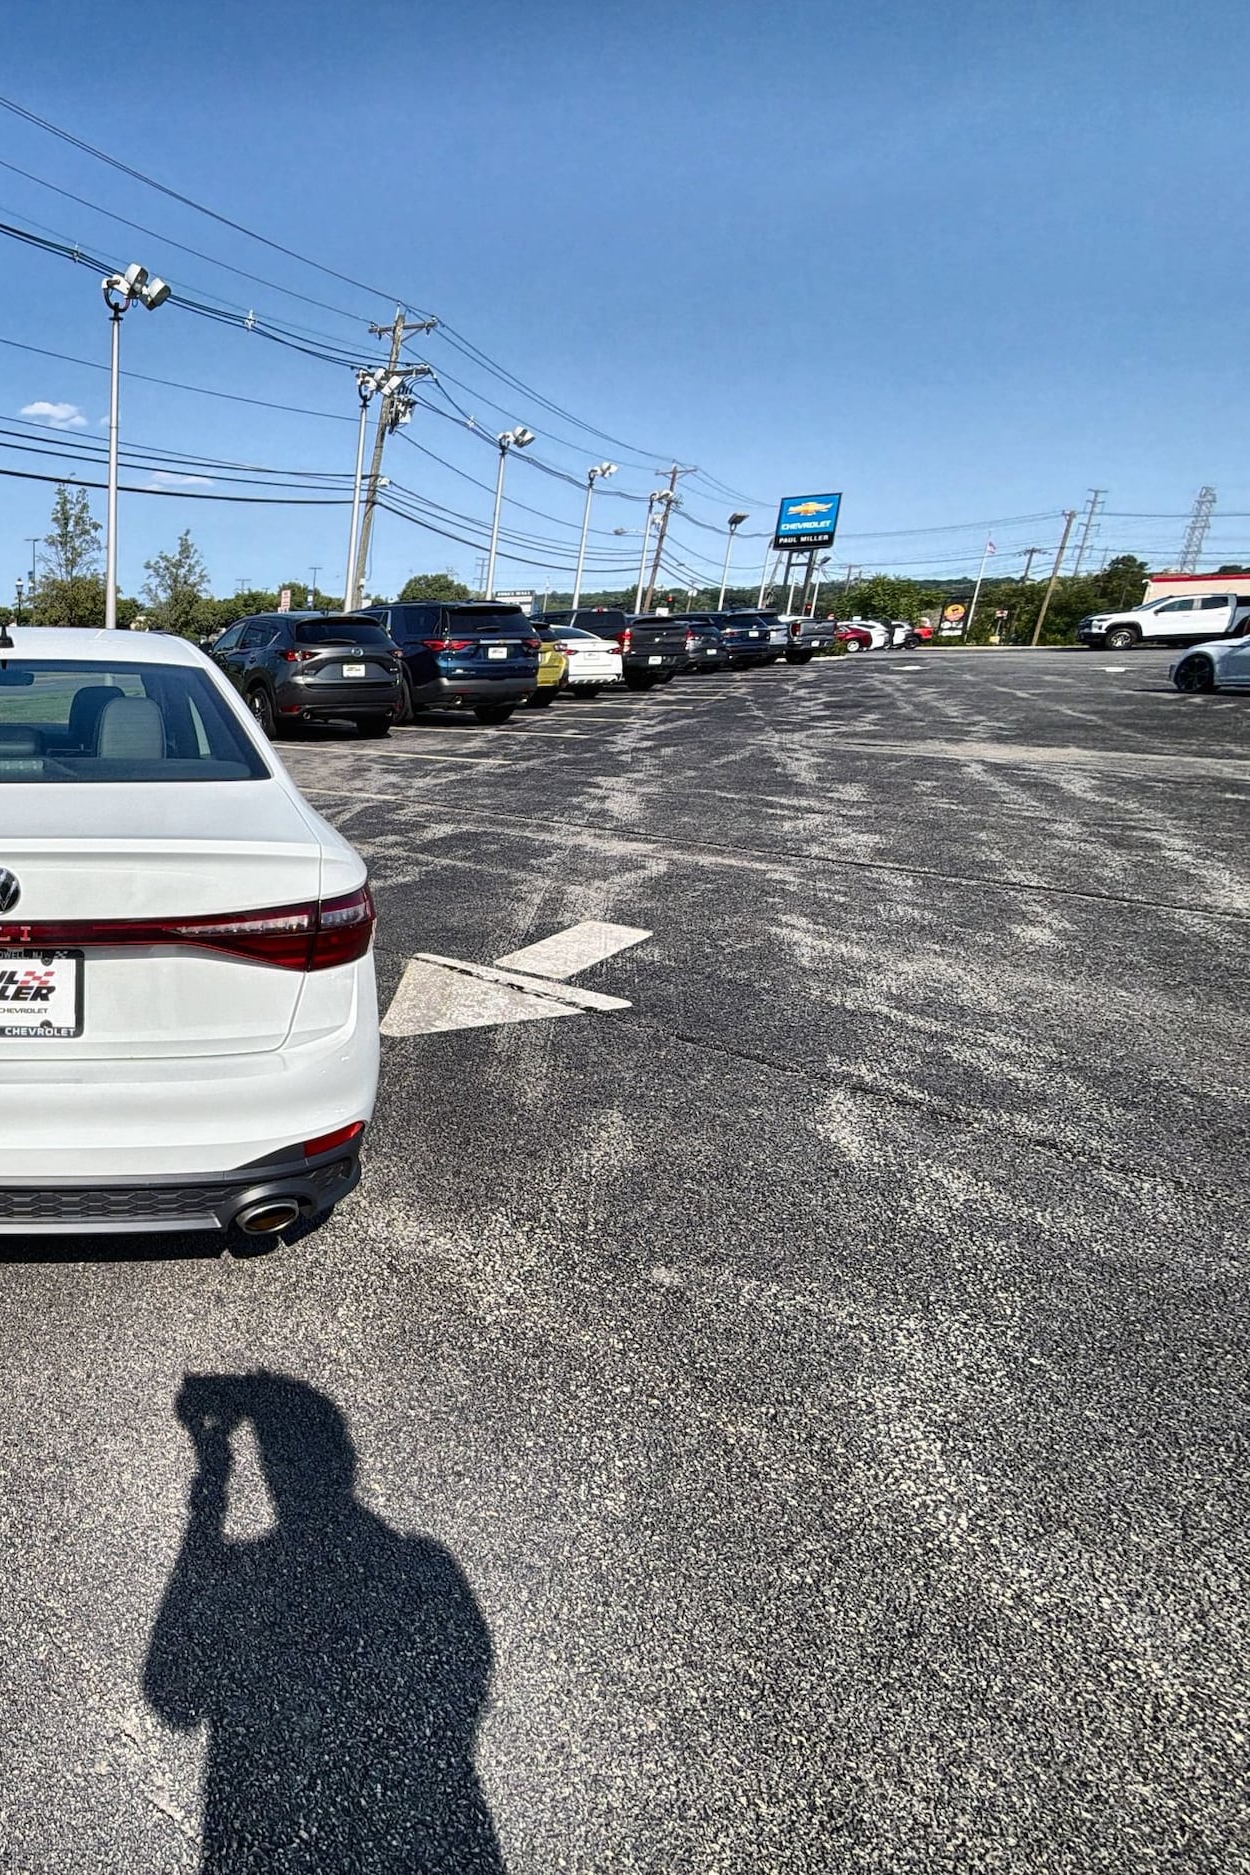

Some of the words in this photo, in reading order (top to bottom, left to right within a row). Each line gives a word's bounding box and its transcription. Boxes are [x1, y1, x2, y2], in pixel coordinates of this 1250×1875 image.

[781, 520, 831, 531] CHEVROLET
[779, 536, 797, 544] PAUL
[800, 534, 829, 543] MILLER
[32, 951, 43, 959] NJ
[5, 1027, 76, 1037] CHEVROLET
